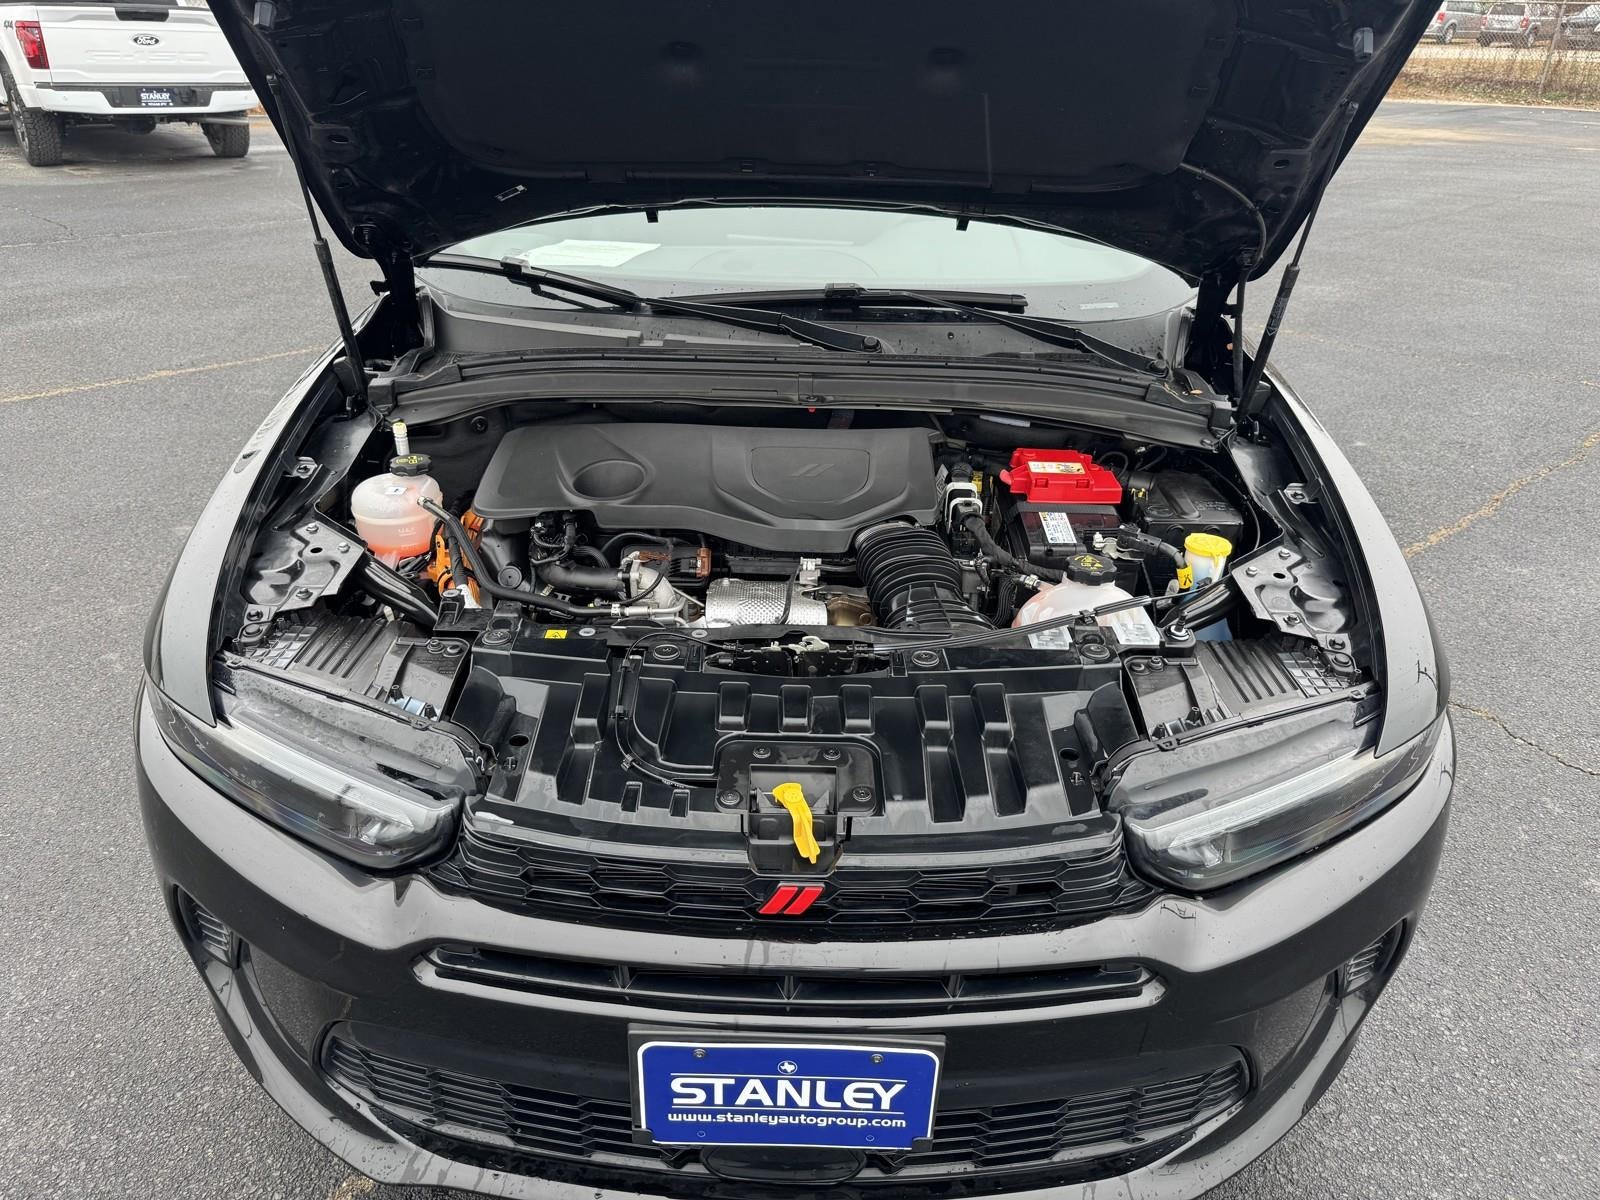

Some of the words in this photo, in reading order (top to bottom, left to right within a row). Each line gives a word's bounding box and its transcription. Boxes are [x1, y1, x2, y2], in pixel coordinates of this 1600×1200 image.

[136, 35, 157, 45] Ford
[670, 1077, 906, 1110] STANLEY
[667, 1111, 907, 1128] www.stanleyautogroup.com
